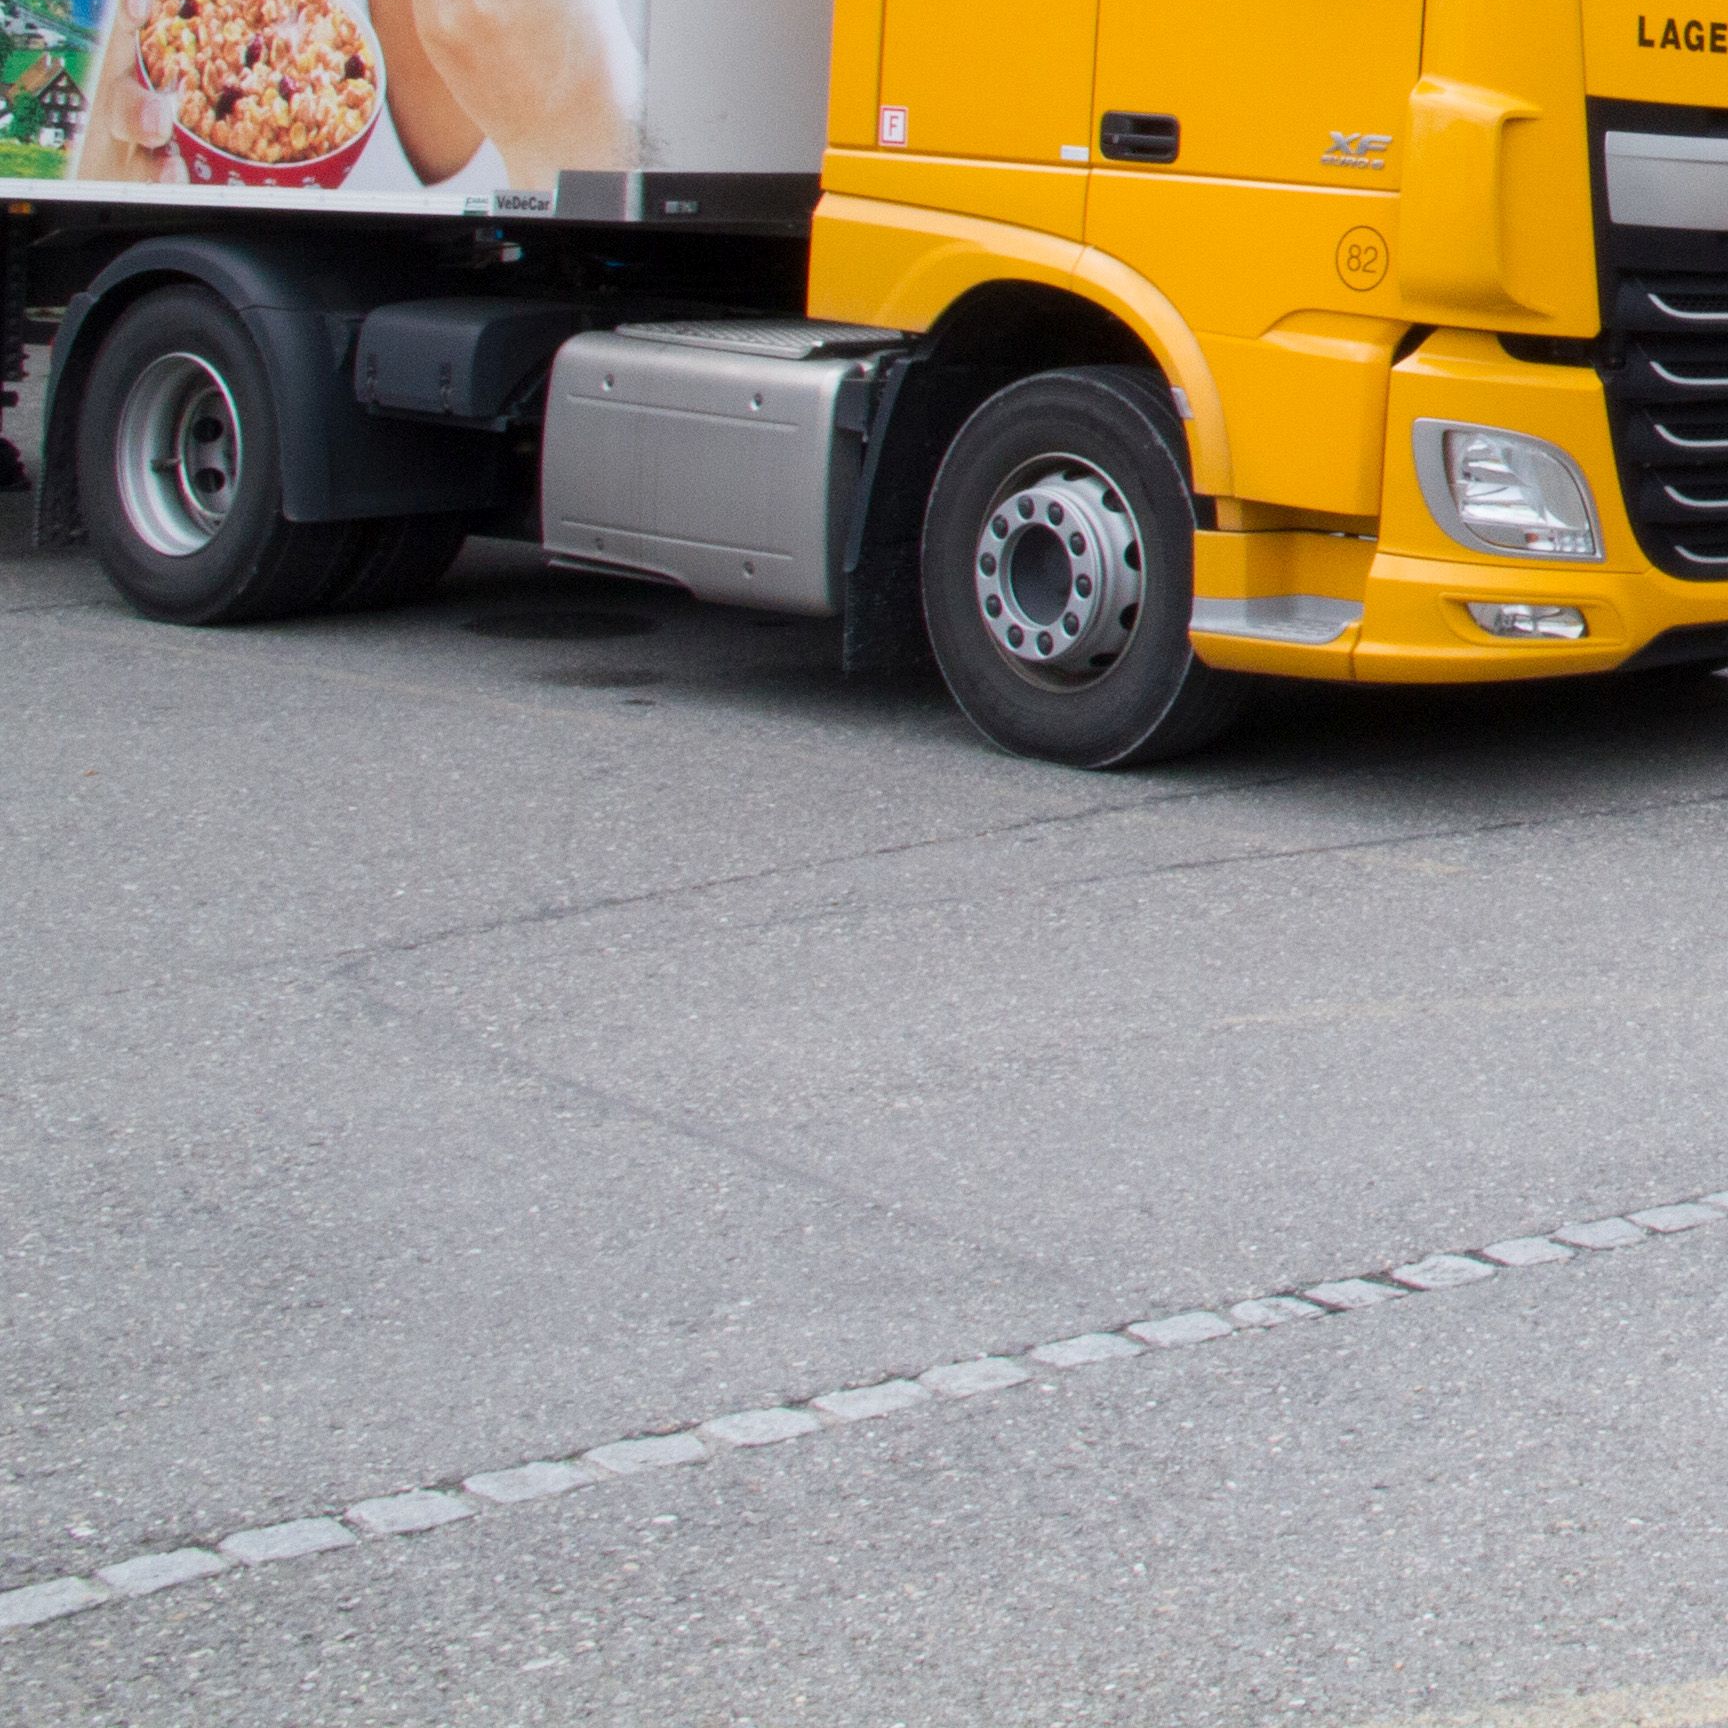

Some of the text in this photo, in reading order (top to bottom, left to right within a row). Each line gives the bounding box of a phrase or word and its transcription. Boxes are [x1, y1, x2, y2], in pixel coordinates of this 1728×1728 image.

[888, 115, 899, 137] F
[1326, 130, 1392, 155] XF
[1347, 244, 1378, 273] 82
